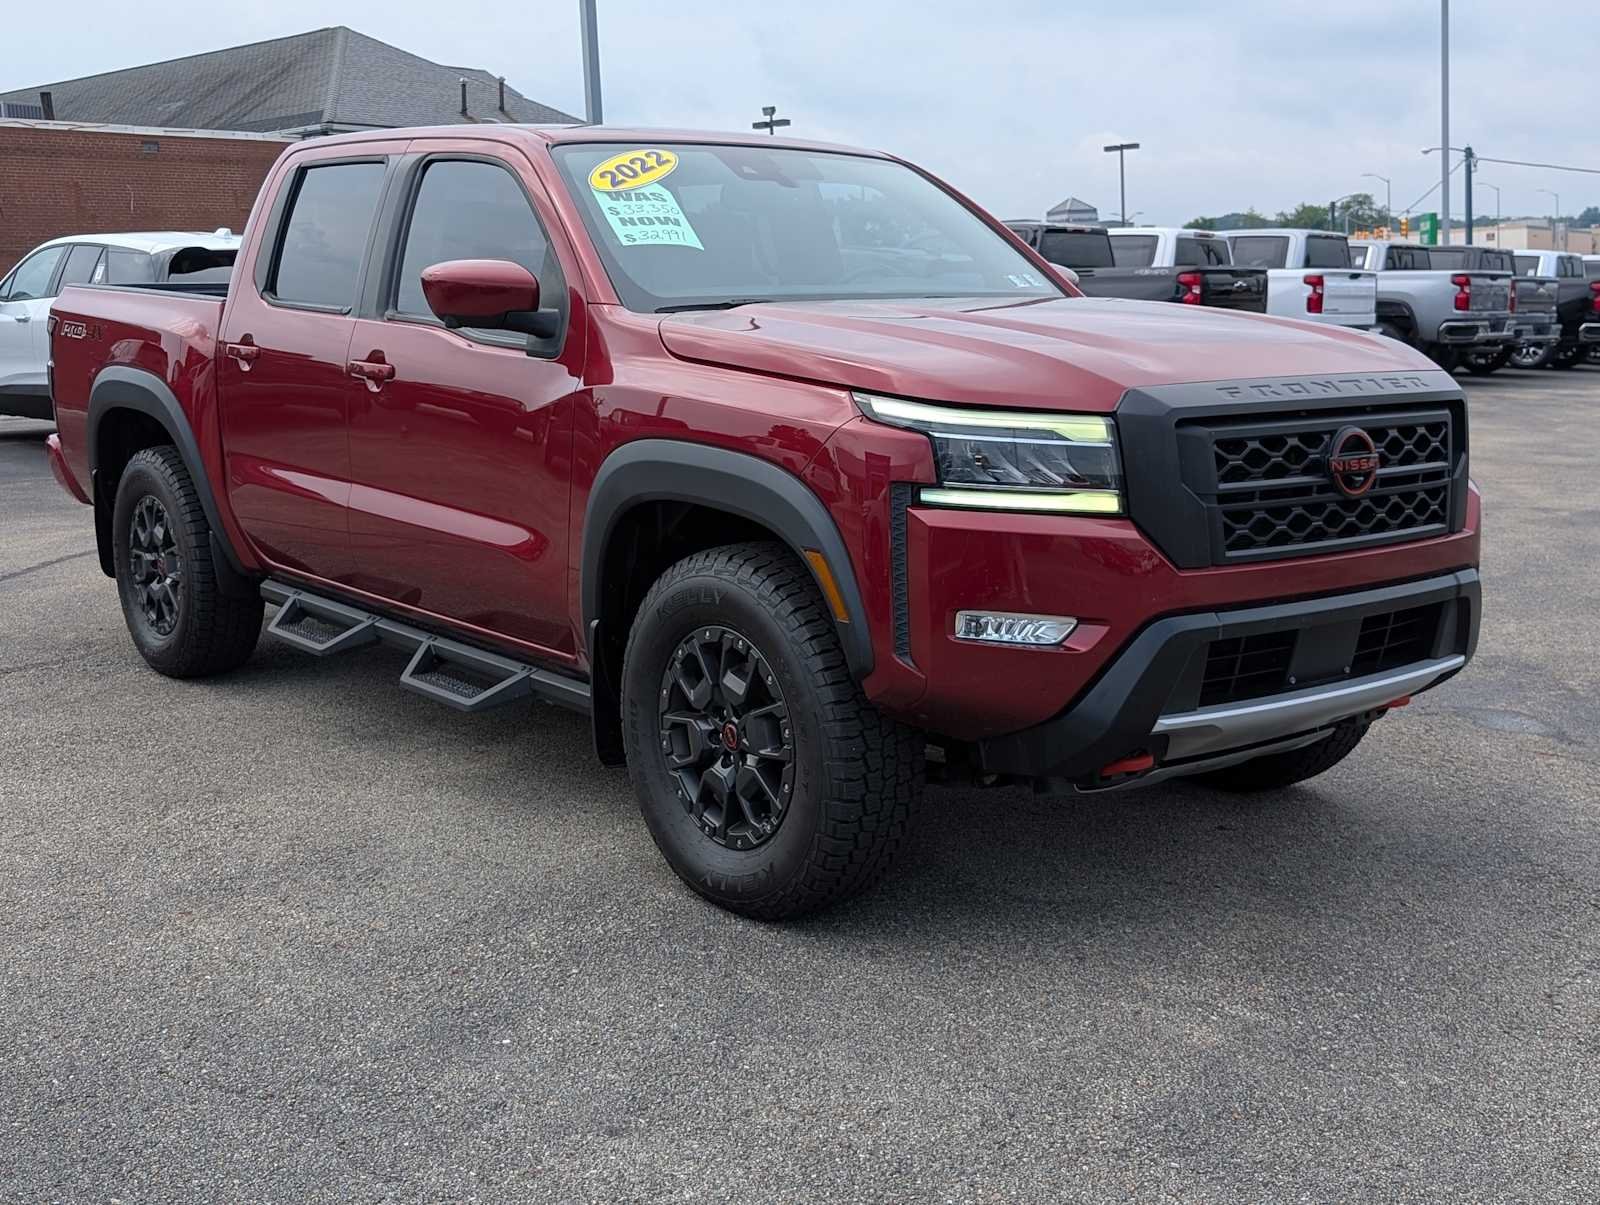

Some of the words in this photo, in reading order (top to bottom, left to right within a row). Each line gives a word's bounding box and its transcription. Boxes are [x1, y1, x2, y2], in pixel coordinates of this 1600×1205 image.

[599, 151, 671, 188] 2022
[607, 192, 668, 202] WAS
[617, 216, 682, 227] NOW
[1216, 376, 1430, 398] FRONTIER
